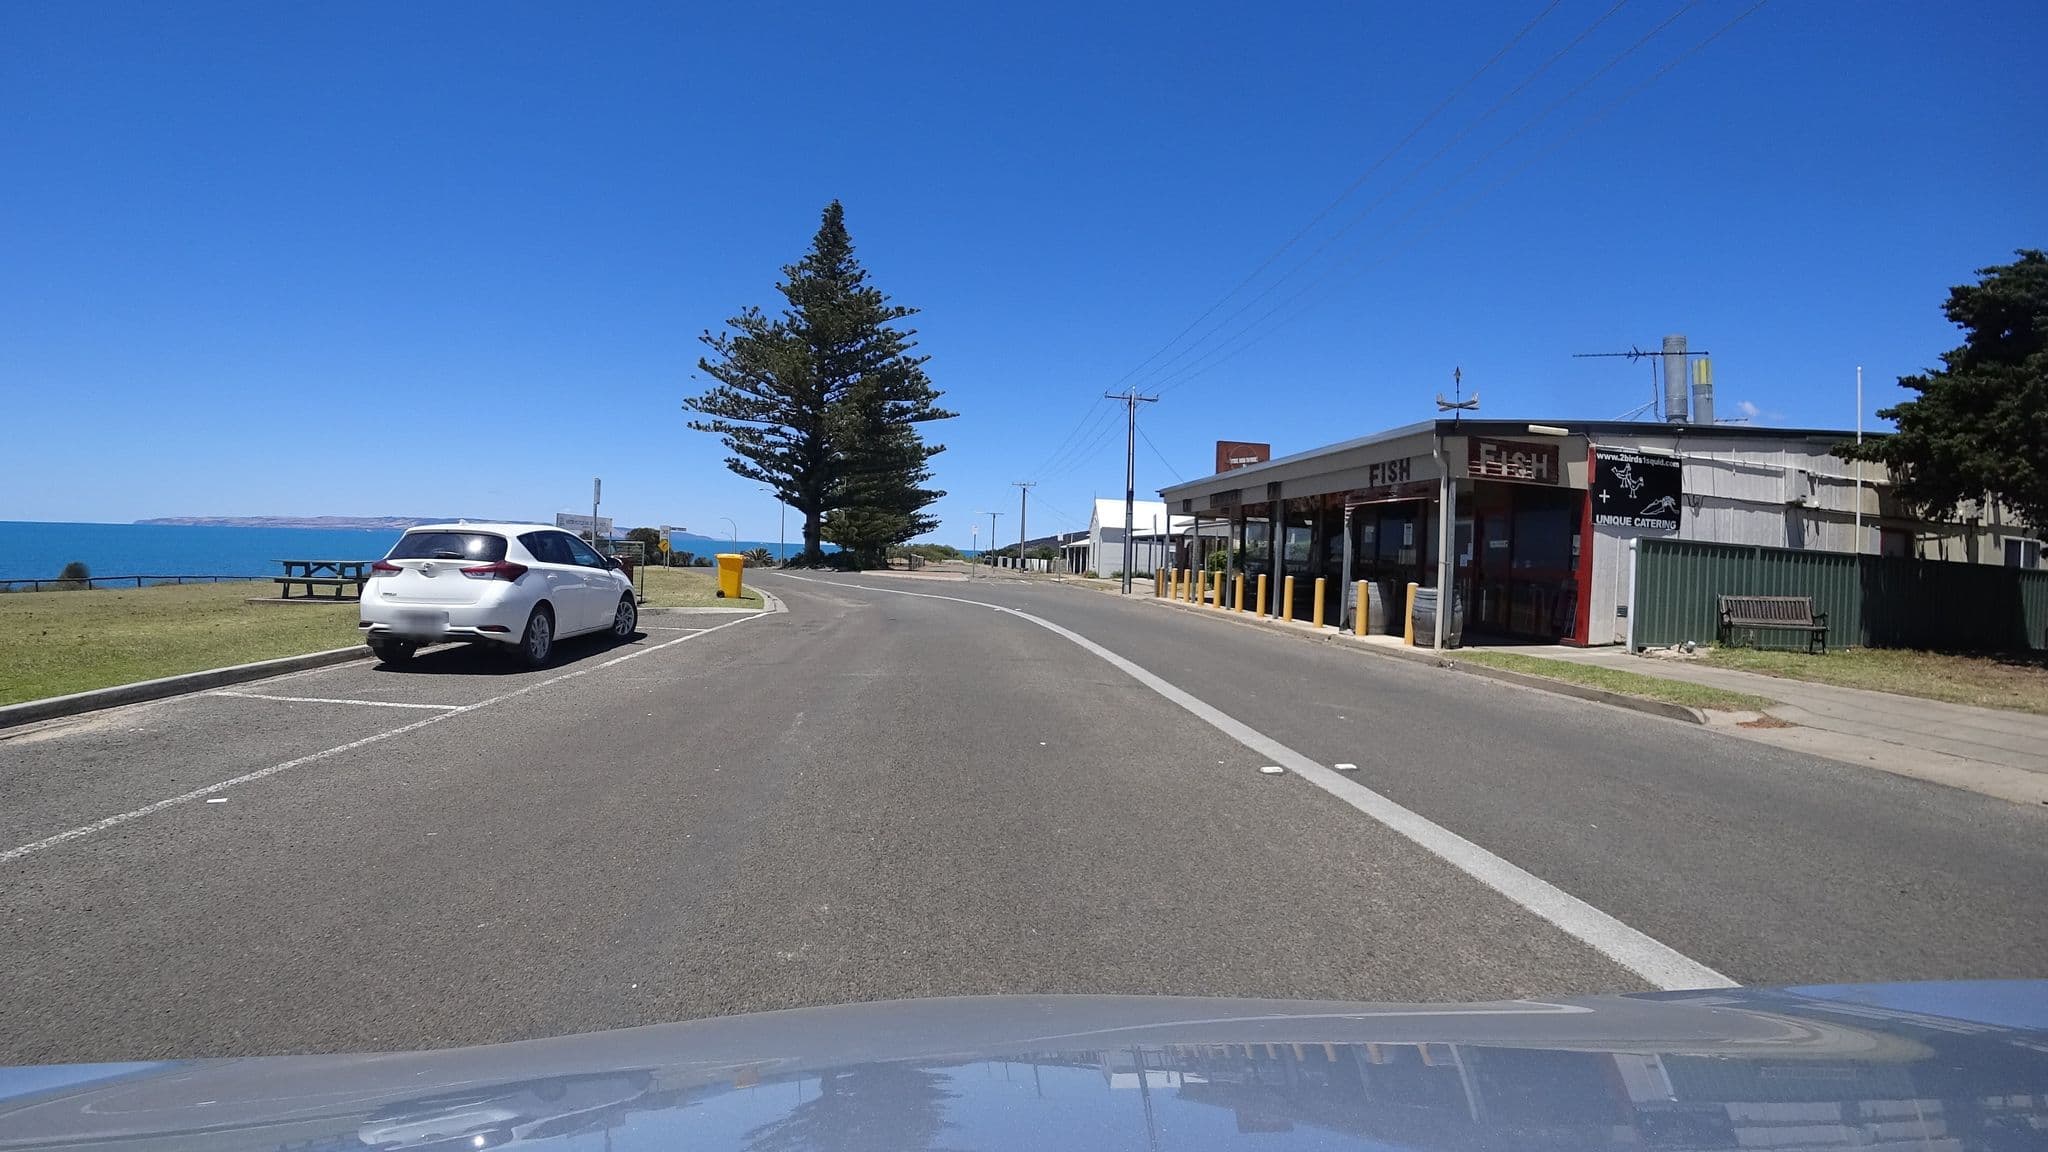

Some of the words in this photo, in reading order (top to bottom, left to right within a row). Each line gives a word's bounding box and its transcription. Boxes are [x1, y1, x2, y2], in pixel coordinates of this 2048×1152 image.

[1369, 457, 1411, 487] FISH
[1480, 442, 1548, 480] FISH
[1595, 514, 1633, 526] UNIQUE
[1634, 518, 1677, 530] CATERING
